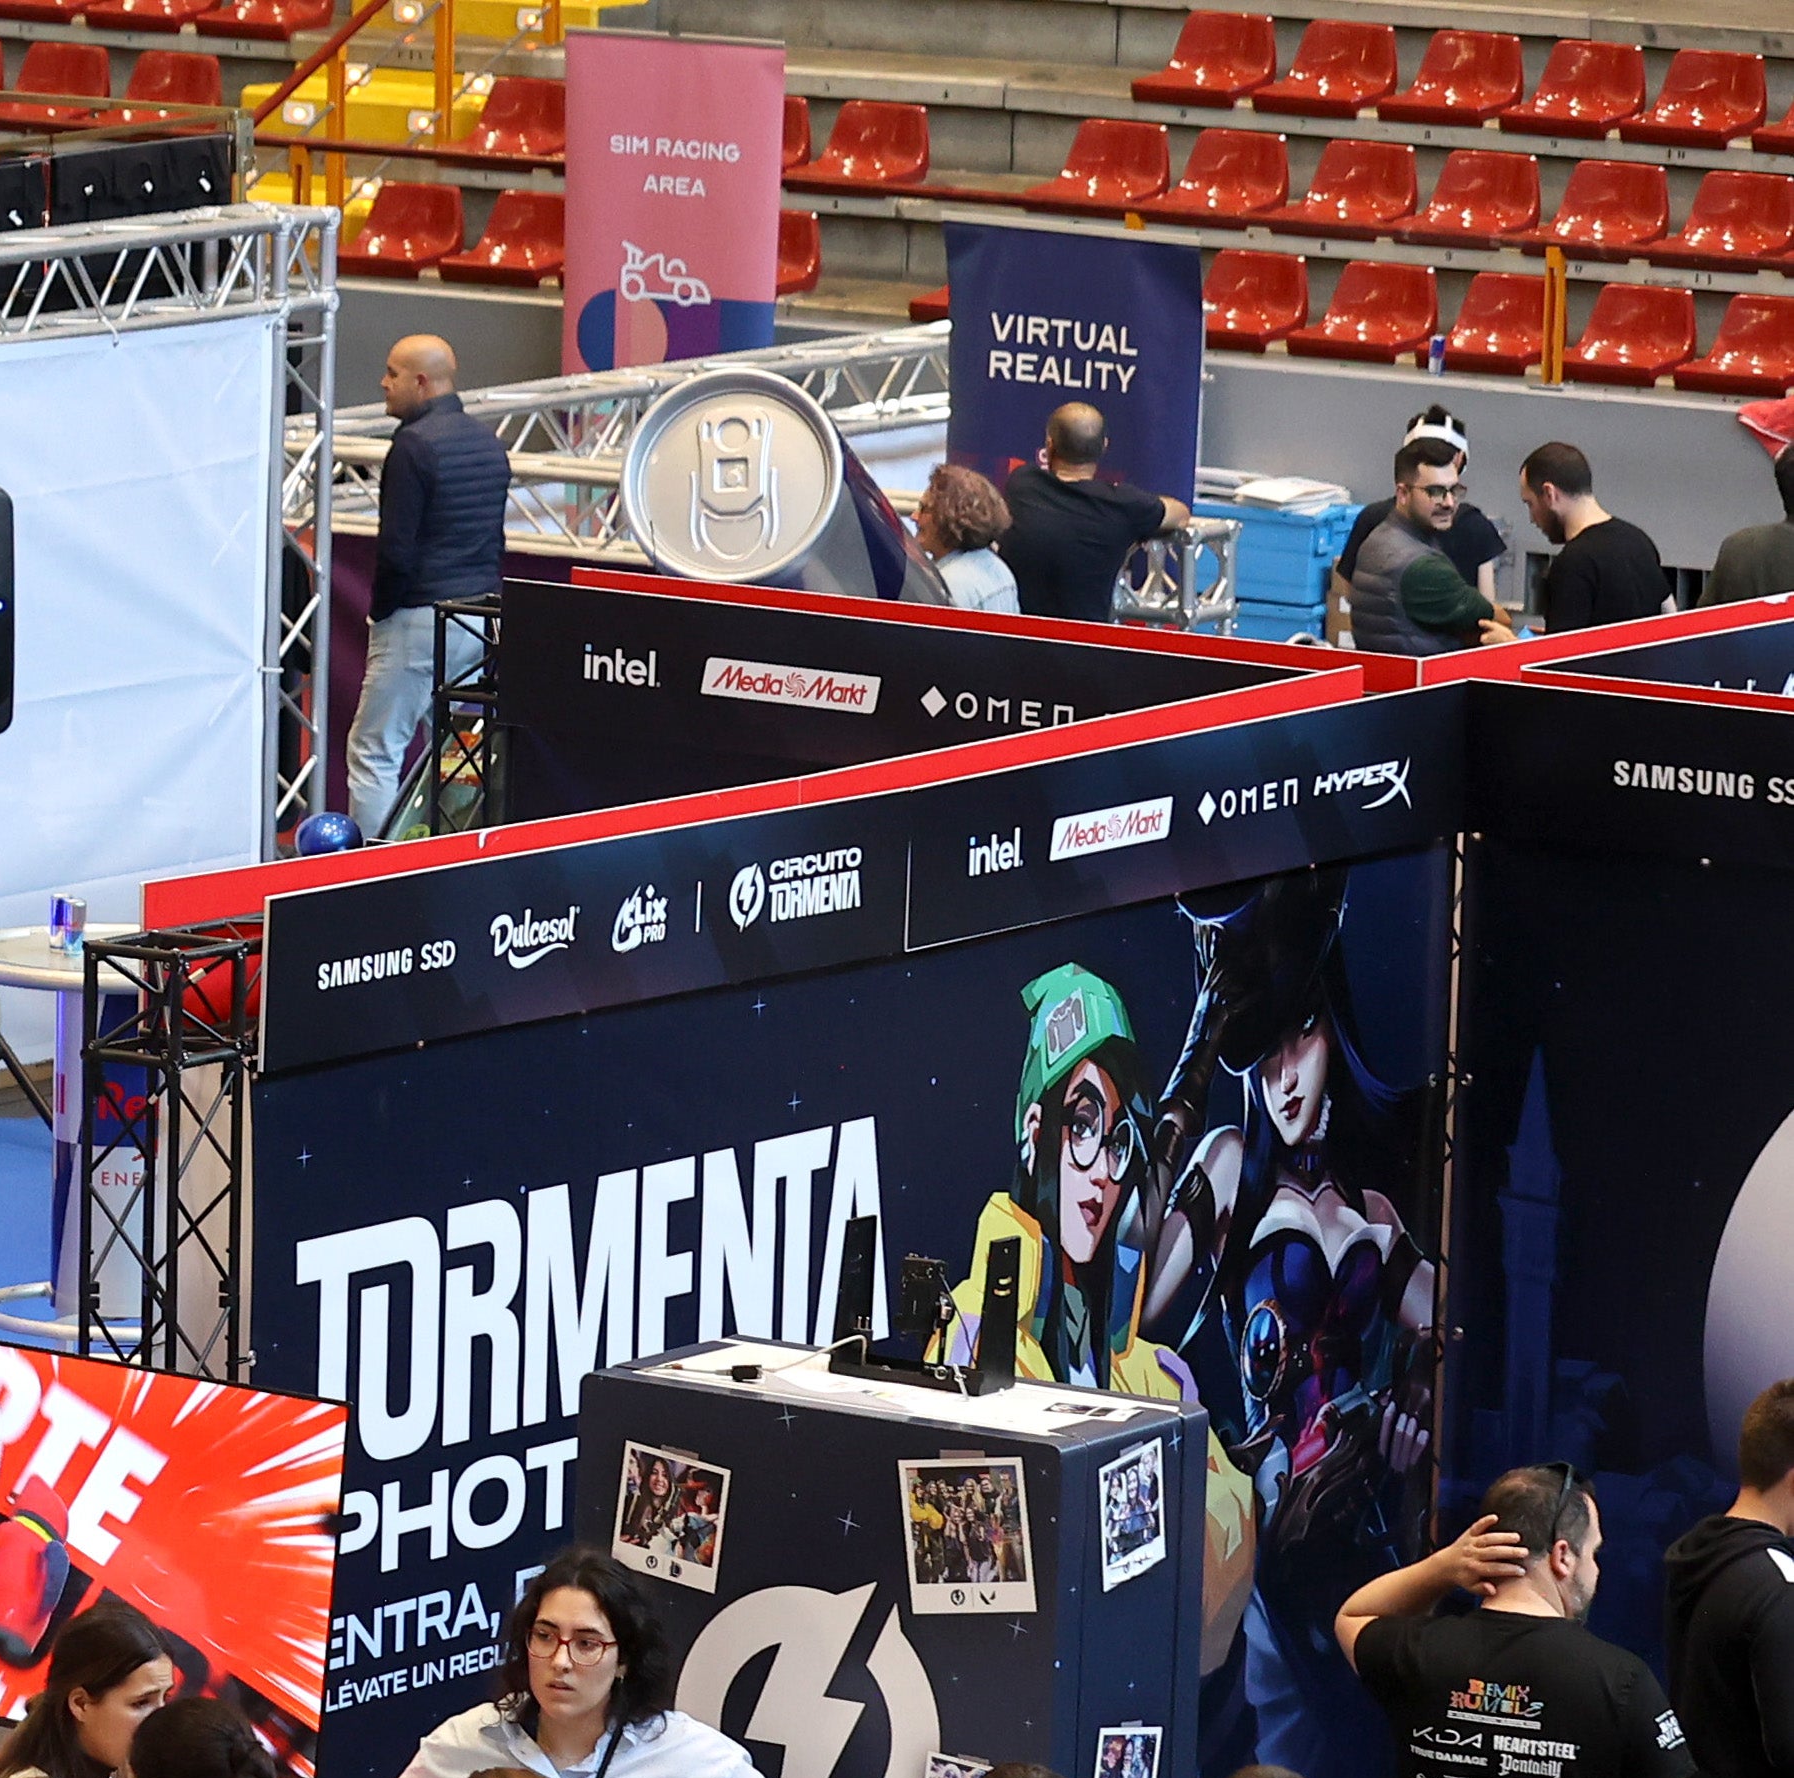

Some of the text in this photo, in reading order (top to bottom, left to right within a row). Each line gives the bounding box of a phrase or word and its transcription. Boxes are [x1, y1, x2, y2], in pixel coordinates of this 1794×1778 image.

[610, 134, 741, 163] SIM RACING
[642, 174, 706, 198] AREA
[990, 311, 1139, 357] VIRTUAL
[988, 349, 1137, 394] REALITY
[583, 643, 661, 688] intel
[712, 664, 867, 706] Media Markt
[1220, 778, 1298, 818] OMEN
[1613, 760, 1754, 799] SAMSUNG
[1058, 807, 1163, 852] Media Markt
[769, 847, 861, 881] CIRCUITO
[968, 827, 1024, 876] intel
[768, 870, 861, 922] TORMENTA
[490, 905, 580, 962] Dulcesol
[642, 921, 667, 944] PRO
[317, 940, 456, 991] SAMSUNG SSD
[295, 1115, 890, 1461] TORMENTA
[325, 1668, 408, 1714] LÉVATE
[412, 1662, 444, 1688] UN
[1449, 1690, 1545, 1718] RUMBLE
[1468, 1678, 1530, 1703] REMIX
[1493, 1734, 1578, 1761] HEARTSTEEL
